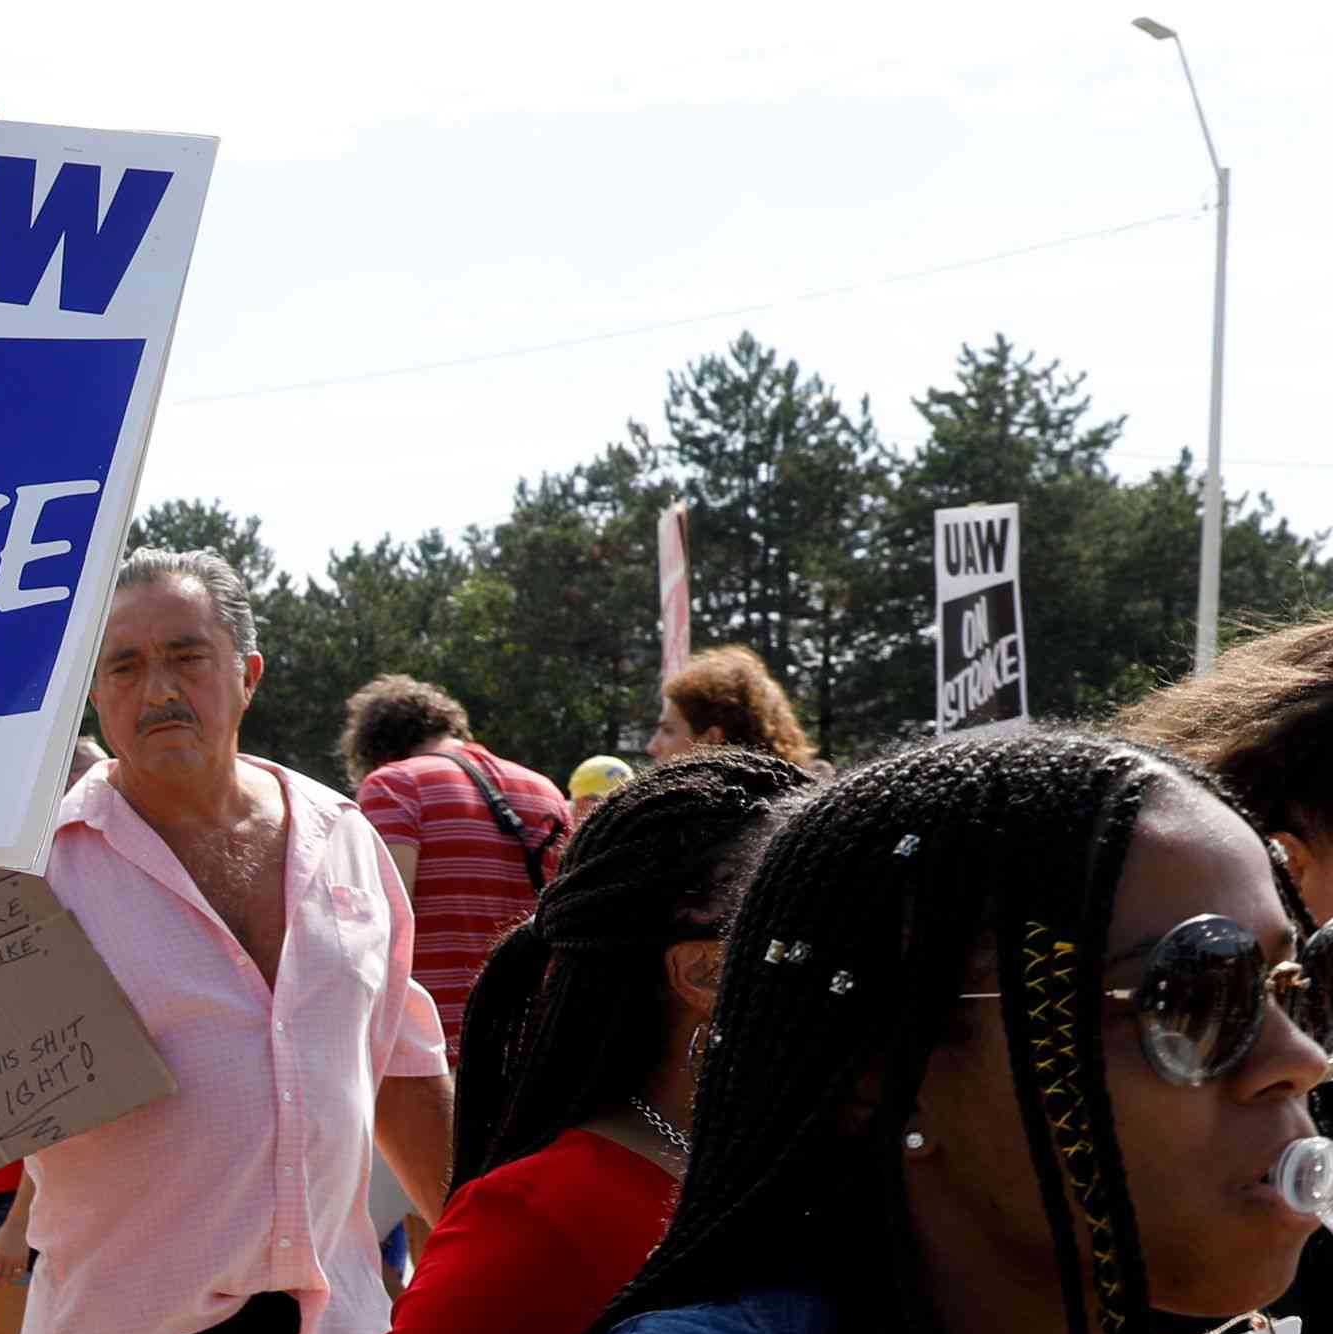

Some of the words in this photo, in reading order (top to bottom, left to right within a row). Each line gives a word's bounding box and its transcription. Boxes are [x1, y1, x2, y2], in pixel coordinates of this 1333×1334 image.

[944, 517, 1010, 577] UAW
[961, 594, 989, 659] ON
[944, 633, 1020, 728] STRIKE
[30, 1014, 86, 1064] SHIT
